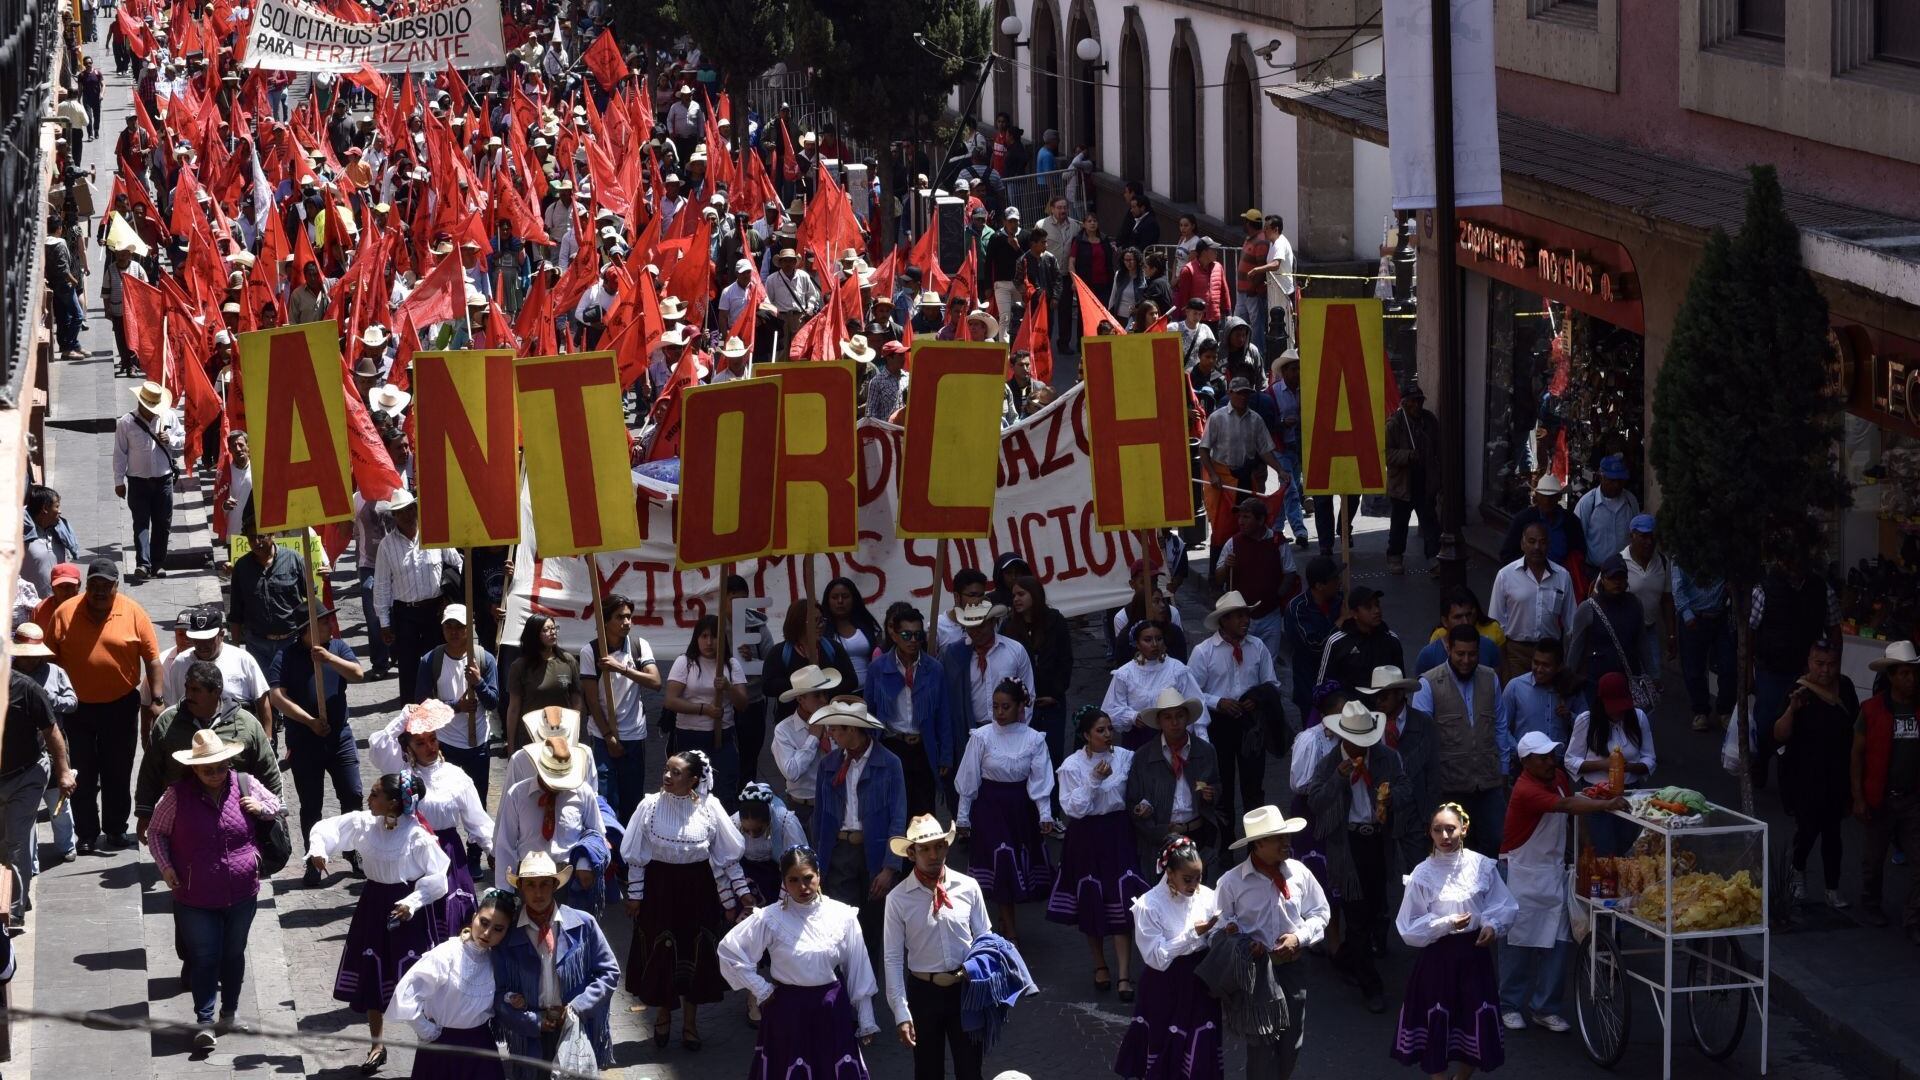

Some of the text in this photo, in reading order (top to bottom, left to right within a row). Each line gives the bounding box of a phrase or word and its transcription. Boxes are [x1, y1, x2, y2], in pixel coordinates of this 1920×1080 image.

[260, 3, 372, 45] SOLICITAMOS
[377, 7, 472, 44] SUBSIDIO
[256, 32, 470, 63] PARA FERTILIZANTE
